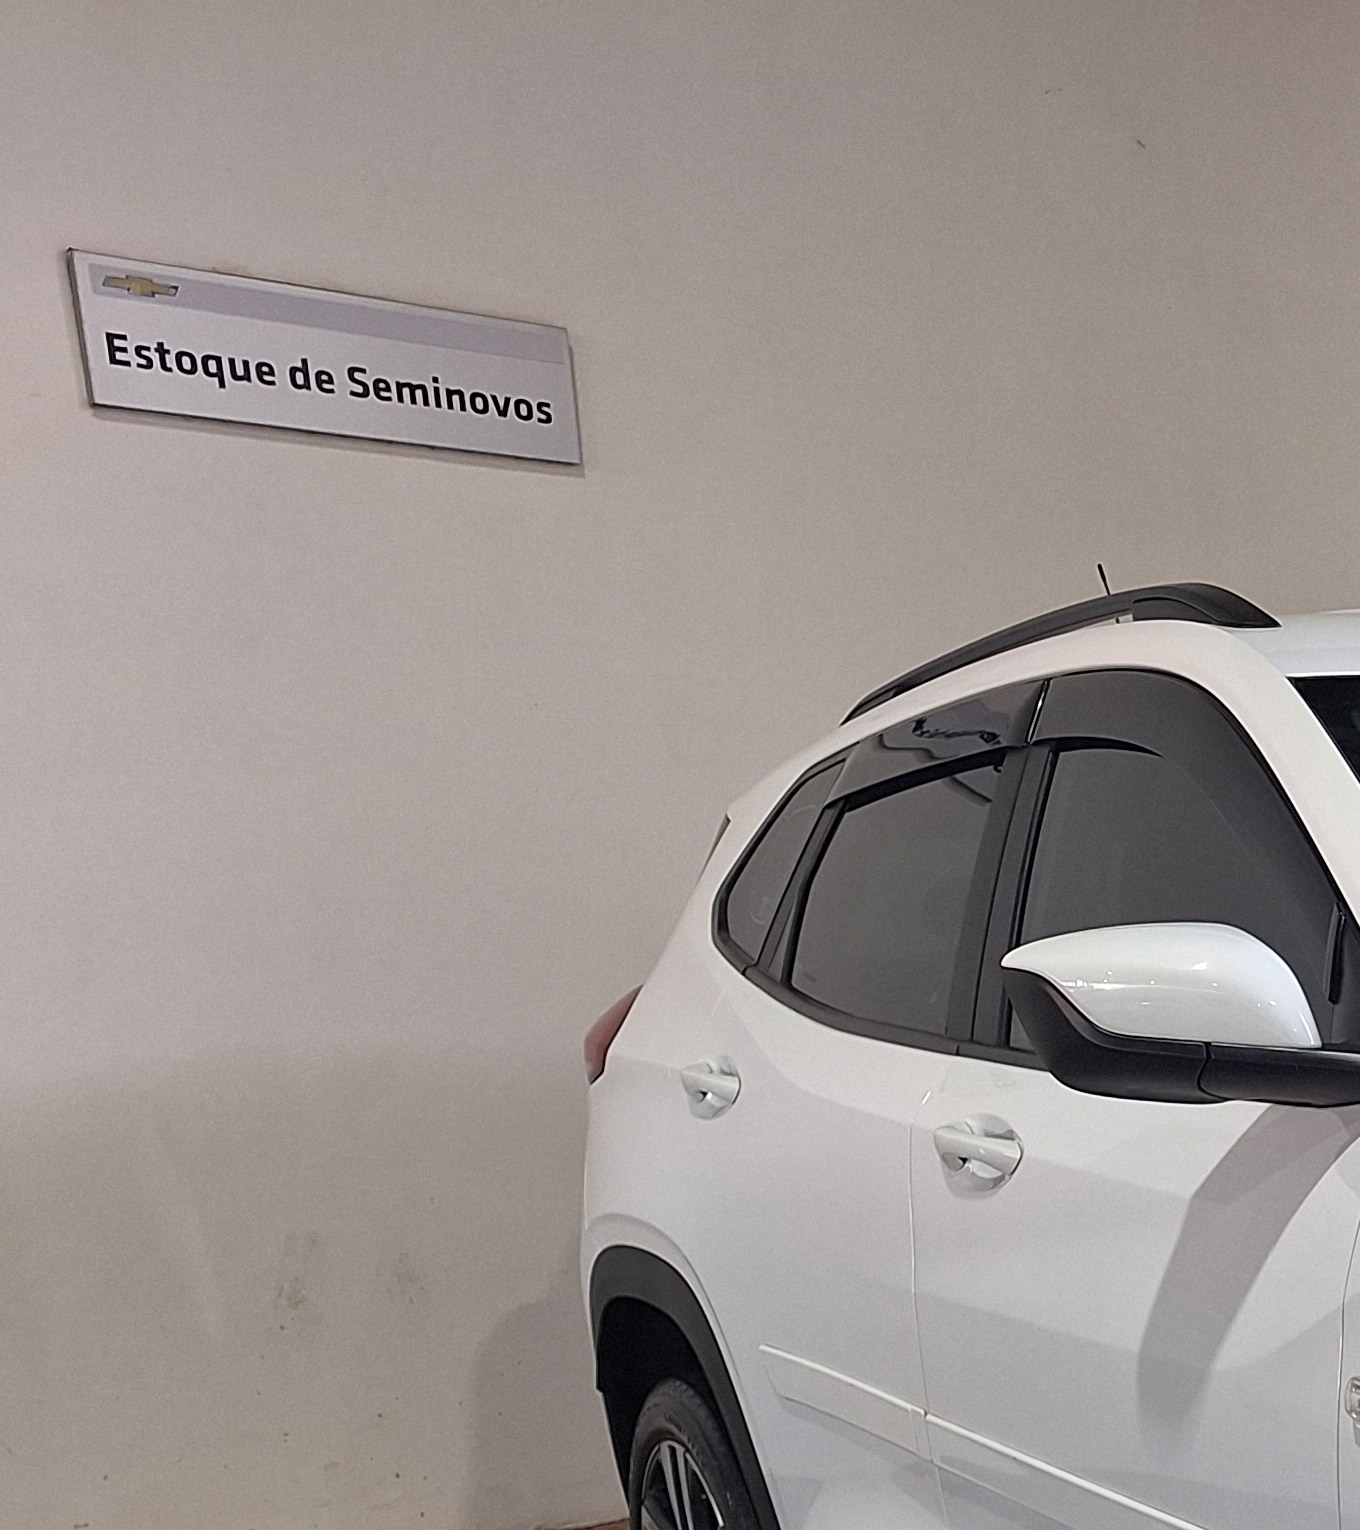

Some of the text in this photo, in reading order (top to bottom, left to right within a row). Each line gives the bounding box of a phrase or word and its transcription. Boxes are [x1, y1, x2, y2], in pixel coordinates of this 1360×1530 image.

[105, 331, 553, 425] Estoque de Seminovos
